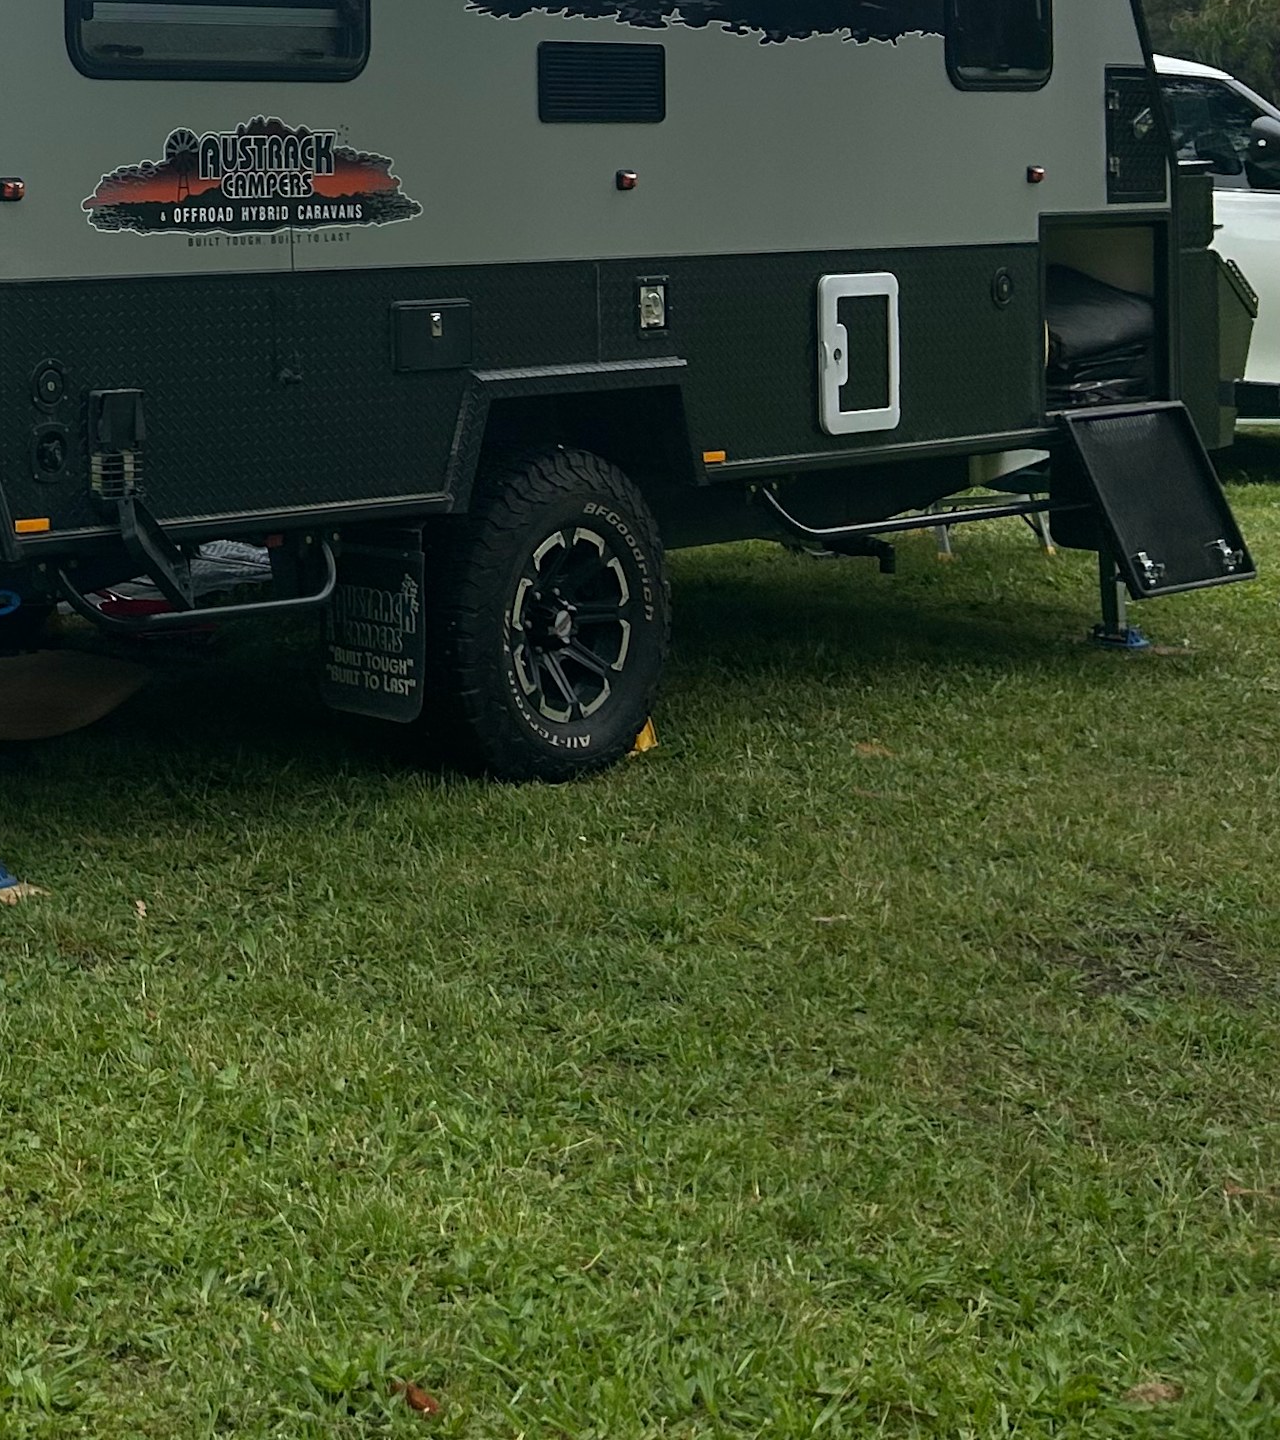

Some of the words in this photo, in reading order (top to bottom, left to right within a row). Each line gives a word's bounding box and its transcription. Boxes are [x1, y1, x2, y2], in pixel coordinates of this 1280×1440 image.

[198, 131, 336, 180] AUSTRACK
[221, 172, 315, 198] CAMPERS
[173, 207, 234, 223] OFFROAD
[241, 205, 289, 221] HYBRID
[297, 203, 363, 220] CARAVANS
[188, 236, 220, 247] BUILT
[271, 233, 302, 245] BUILT
[306, 233, 320, 243] TO
[324, 232, 351, 243] LAST
[583, 502, 654, 622] BFGoodrich
[333, 583, 417, 634] AUSTRACK
[344, 620, 403, 653] CAMPERS
[363, 670, 380, 690] TO
[507, 670, 591, 749] All-Terrain
